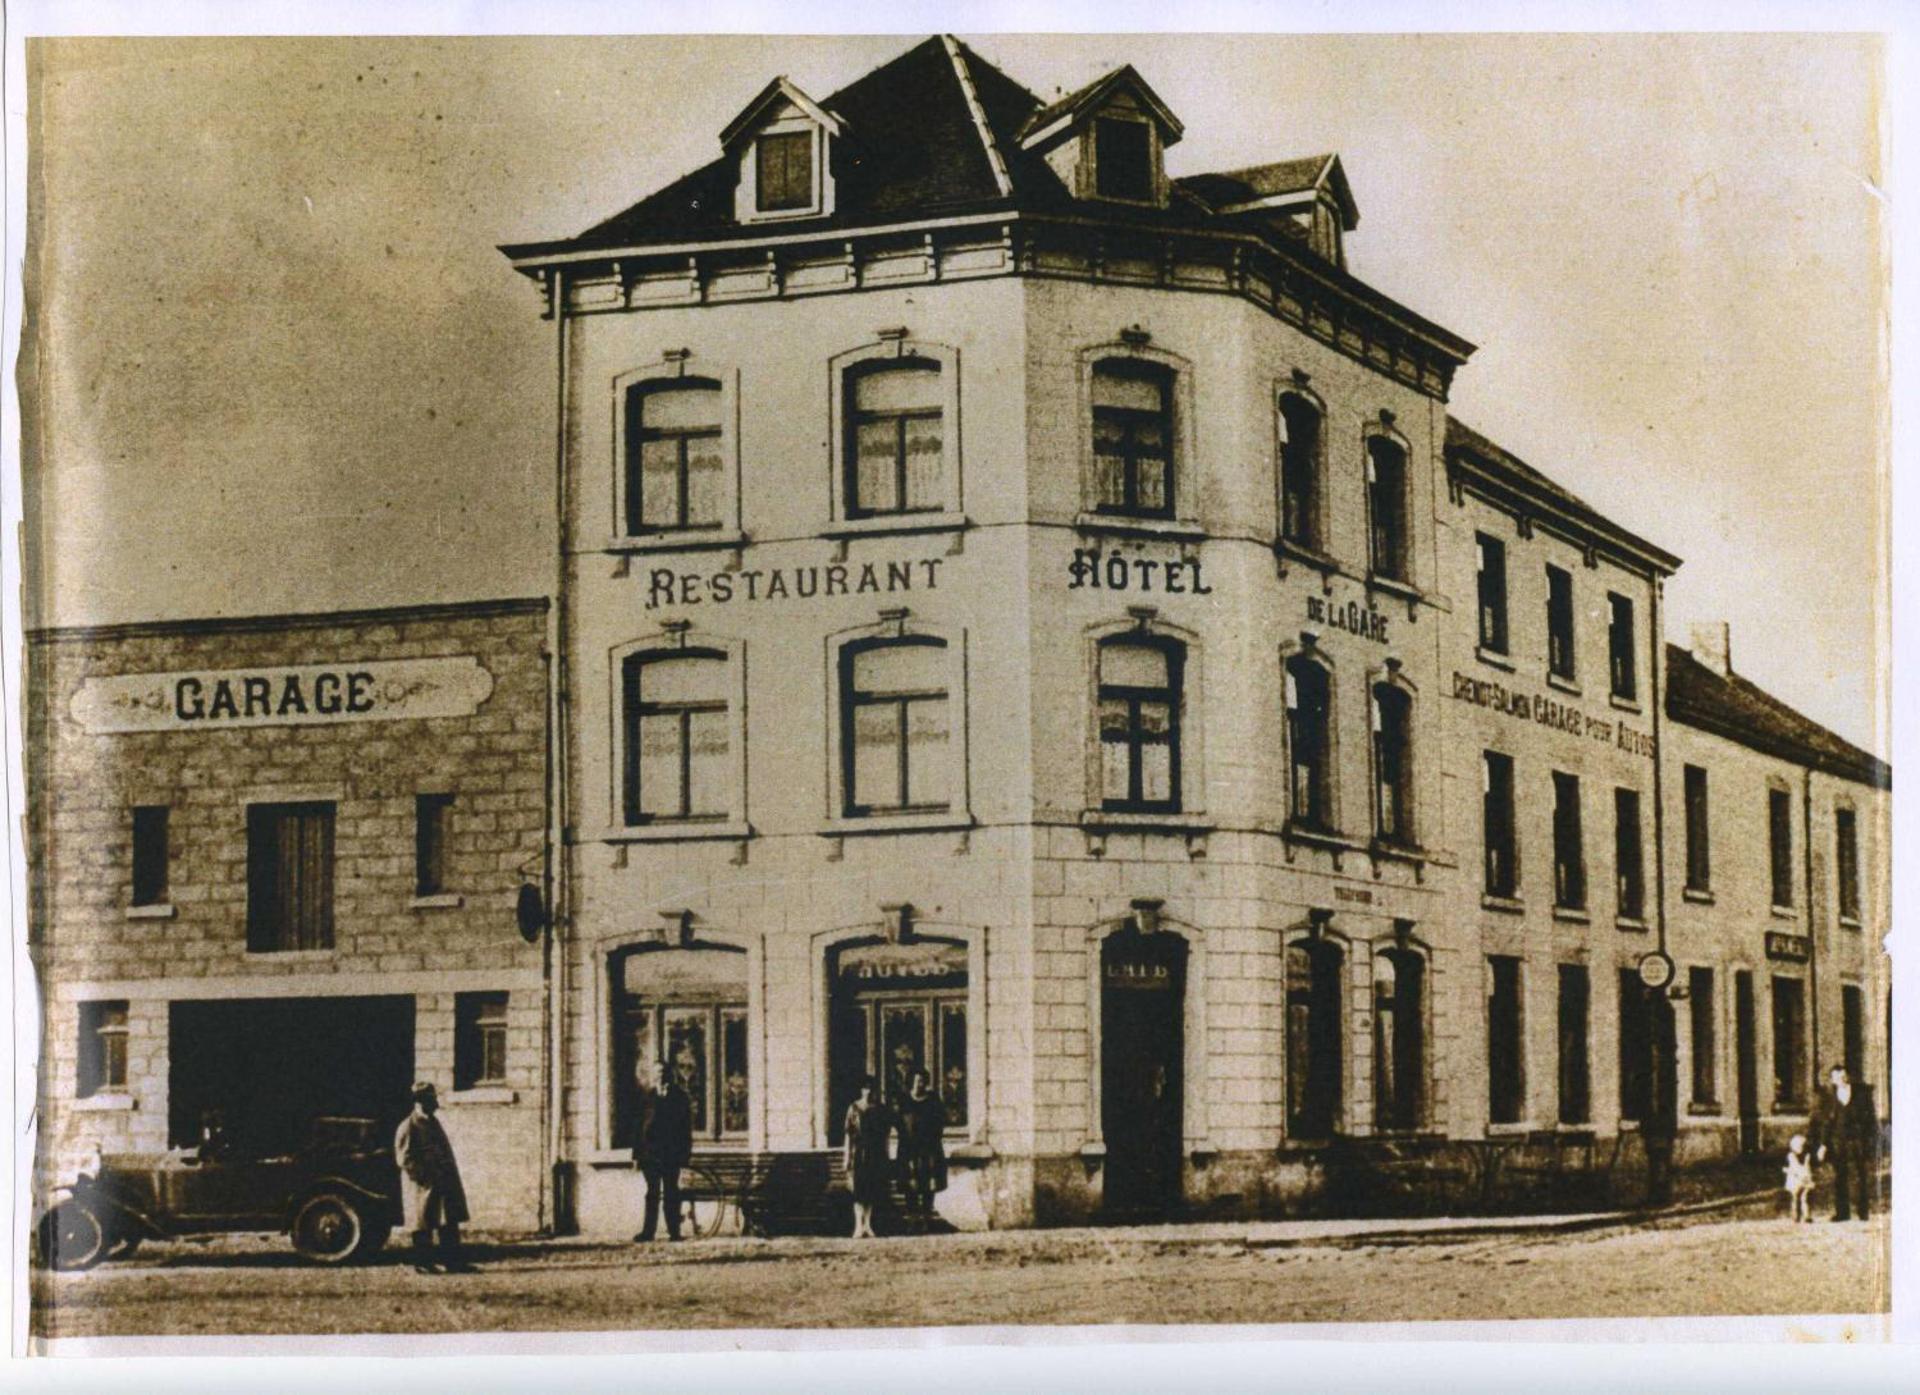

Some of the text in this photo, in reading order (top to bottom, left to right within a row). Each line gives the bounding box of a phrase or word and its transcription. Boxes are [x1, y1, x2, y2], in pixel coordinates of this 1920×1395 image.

[645, 558, 943, 610] RESTAURANT
[1068, 549, 1212, 594] HÔTEL
[1307, 596, 1389, 645] DE LA GARE
[176, 672, 375, 720] GARAGE
[1533, 694, 1582, 737] GARAGE
